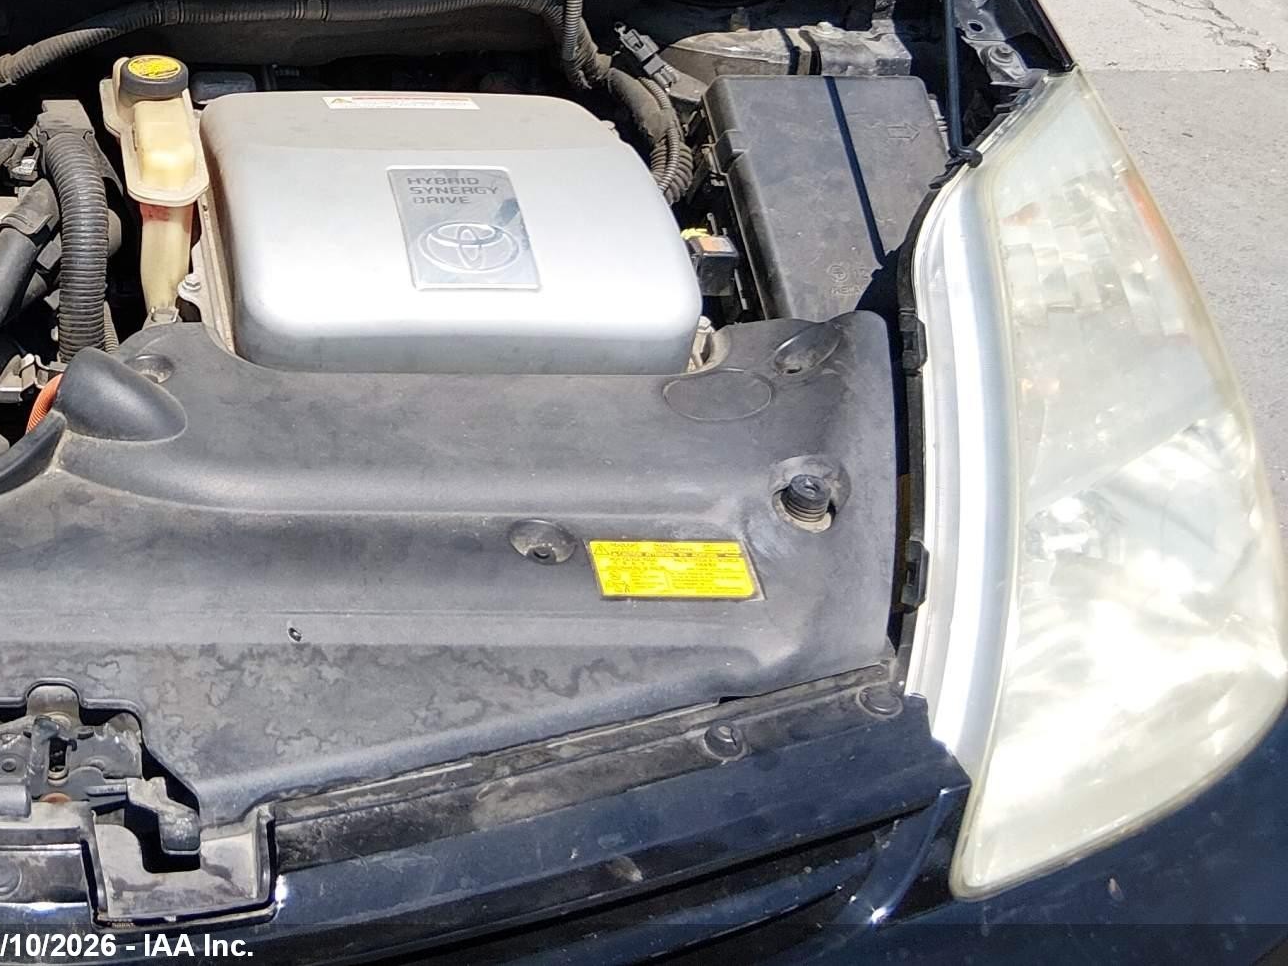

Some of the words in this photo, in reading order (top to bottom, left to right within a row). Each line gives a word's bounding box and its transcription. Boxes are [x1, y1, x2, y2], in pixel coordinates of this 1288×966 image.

[406, 177, 480, 185] HYBRID
[409, 186, 499, 195] SYNERGY
[413, 196, 471, 204] DRIVE
